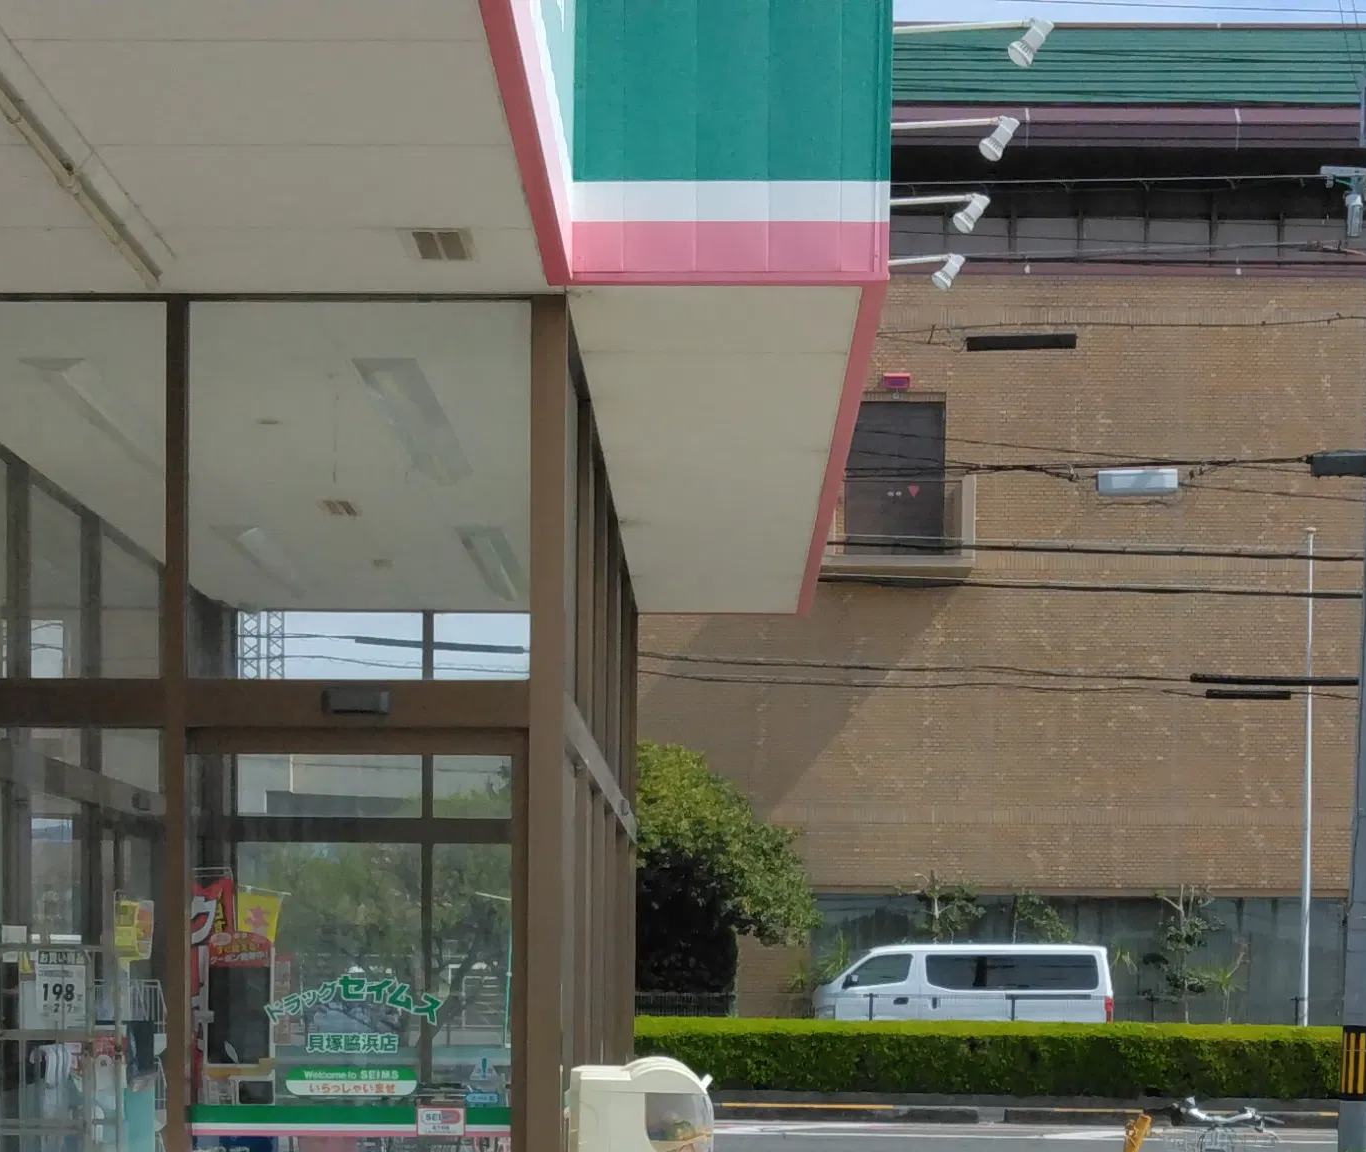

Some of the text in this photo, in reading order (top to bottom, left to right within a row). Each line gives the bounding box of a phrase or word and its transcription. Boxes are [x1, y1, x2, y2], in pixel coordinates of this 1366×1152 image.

[42, 983, 75, 1002] 198
[264, 974, 441, 1025] ドラッグセイムス
[303, 1069, 400, 1080] Welcome to SEIMS
[309, 1083, 396, 1094] いらっしゃいませ
